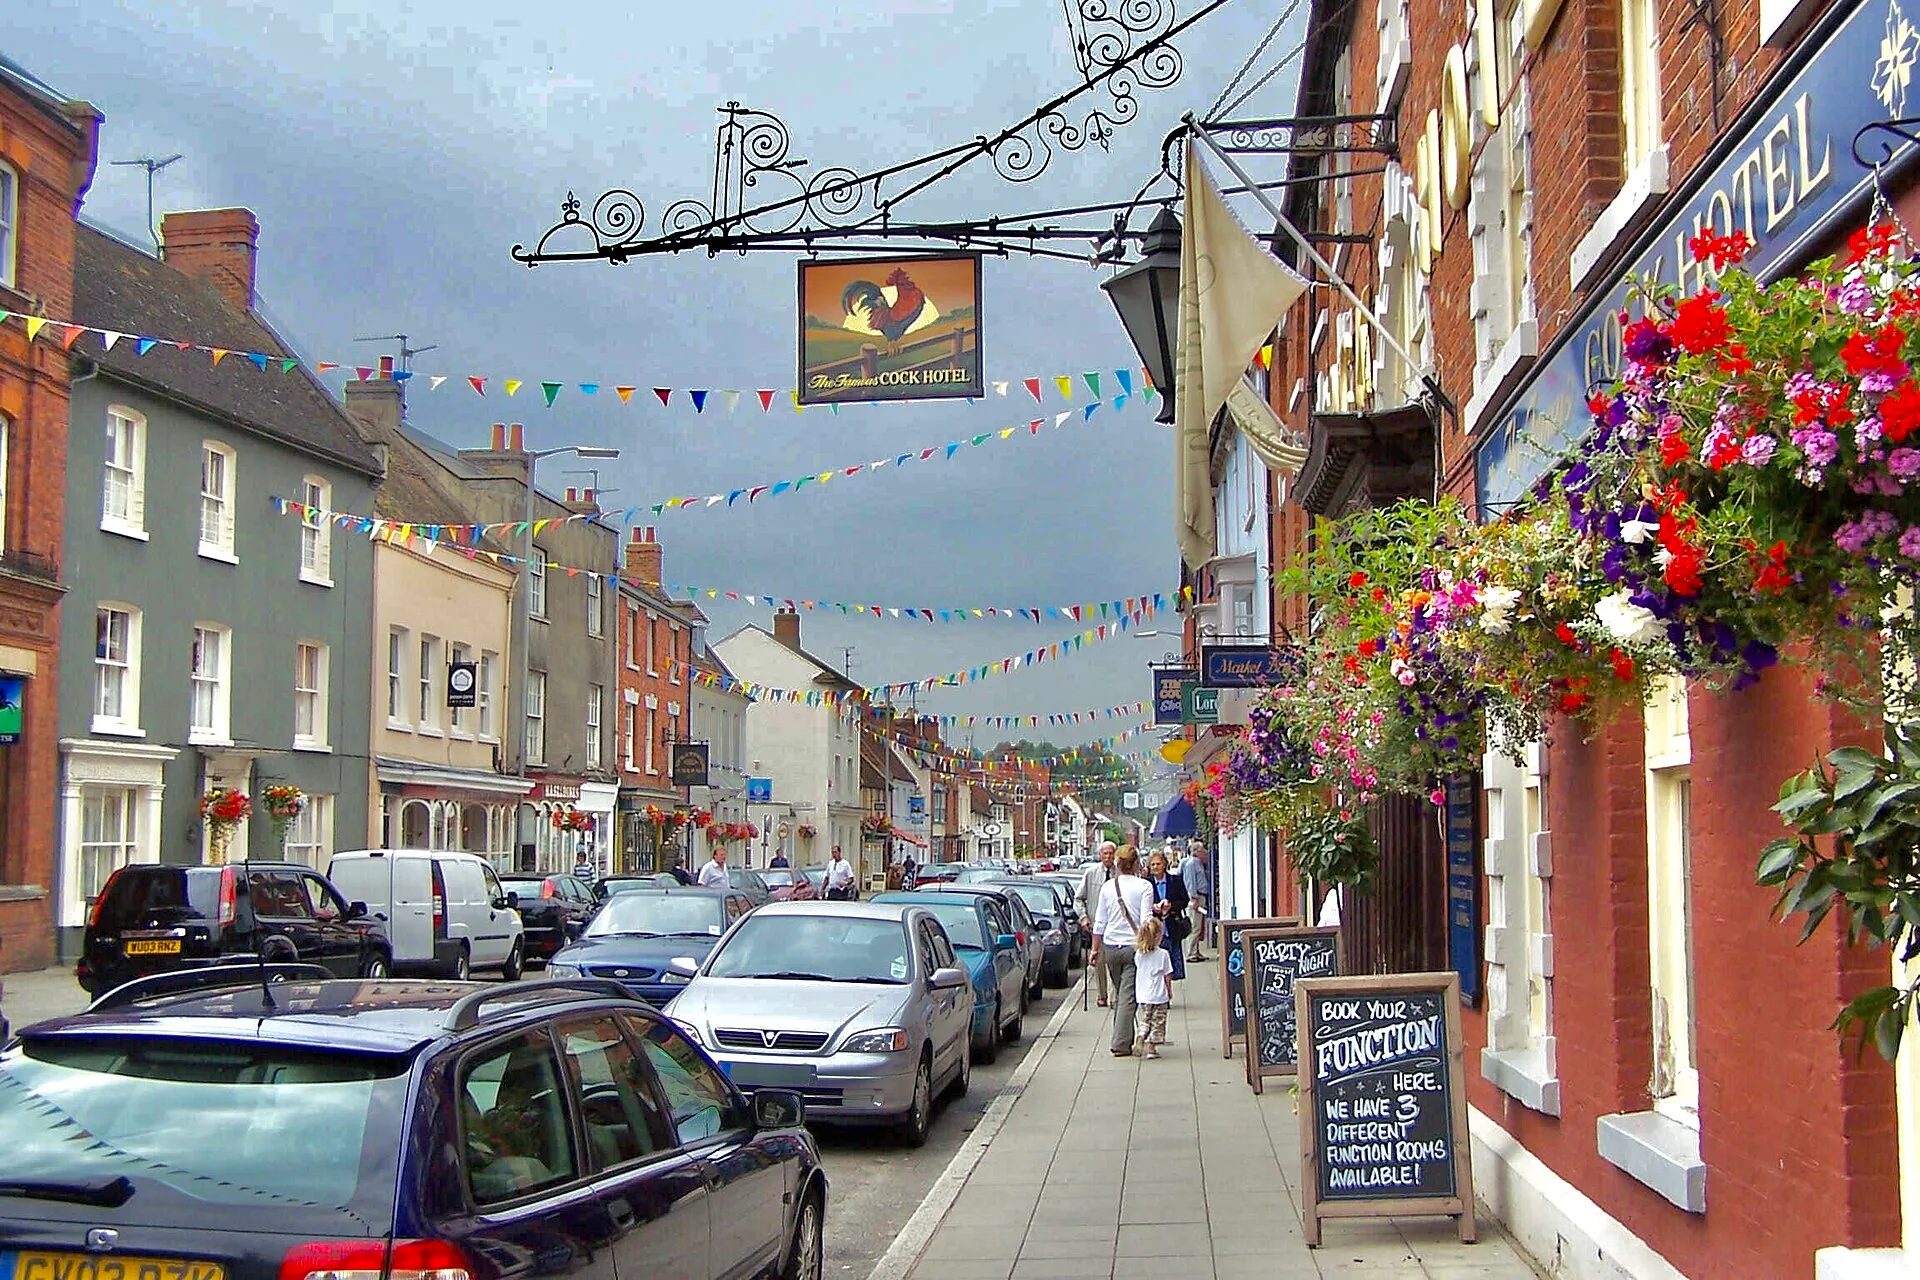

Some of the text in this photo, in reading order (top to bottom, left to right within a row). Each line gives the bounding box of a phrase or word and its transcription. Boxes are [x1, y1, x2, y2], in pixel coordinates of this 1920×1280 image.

[808, 374, 834, 389] The
[879, 371, 921, 385] COCK
[923, 369, 971, 383] HOTEL
[1256, 941, 1311, 962] PARTY
[1298, 950, 1333, 974] NIGHT
[1272, 974, 1286, 989] 5
[1321, 1001, 1407, 1021] BOOK YOUR
[1316, 1015, 1440, 1080] FUNCTION
[1394, 1072, 1442, 1092] HERE.
[1326, 1095, 1419, 1121] WE HAVE 3
[1327, 1120, 1414, 1142] DIFFERENT
[1327, 1140, 1446, 1164] FUNCTION ROOMS
[1330, 1165, 1420, 1187] AVAILABLE!
